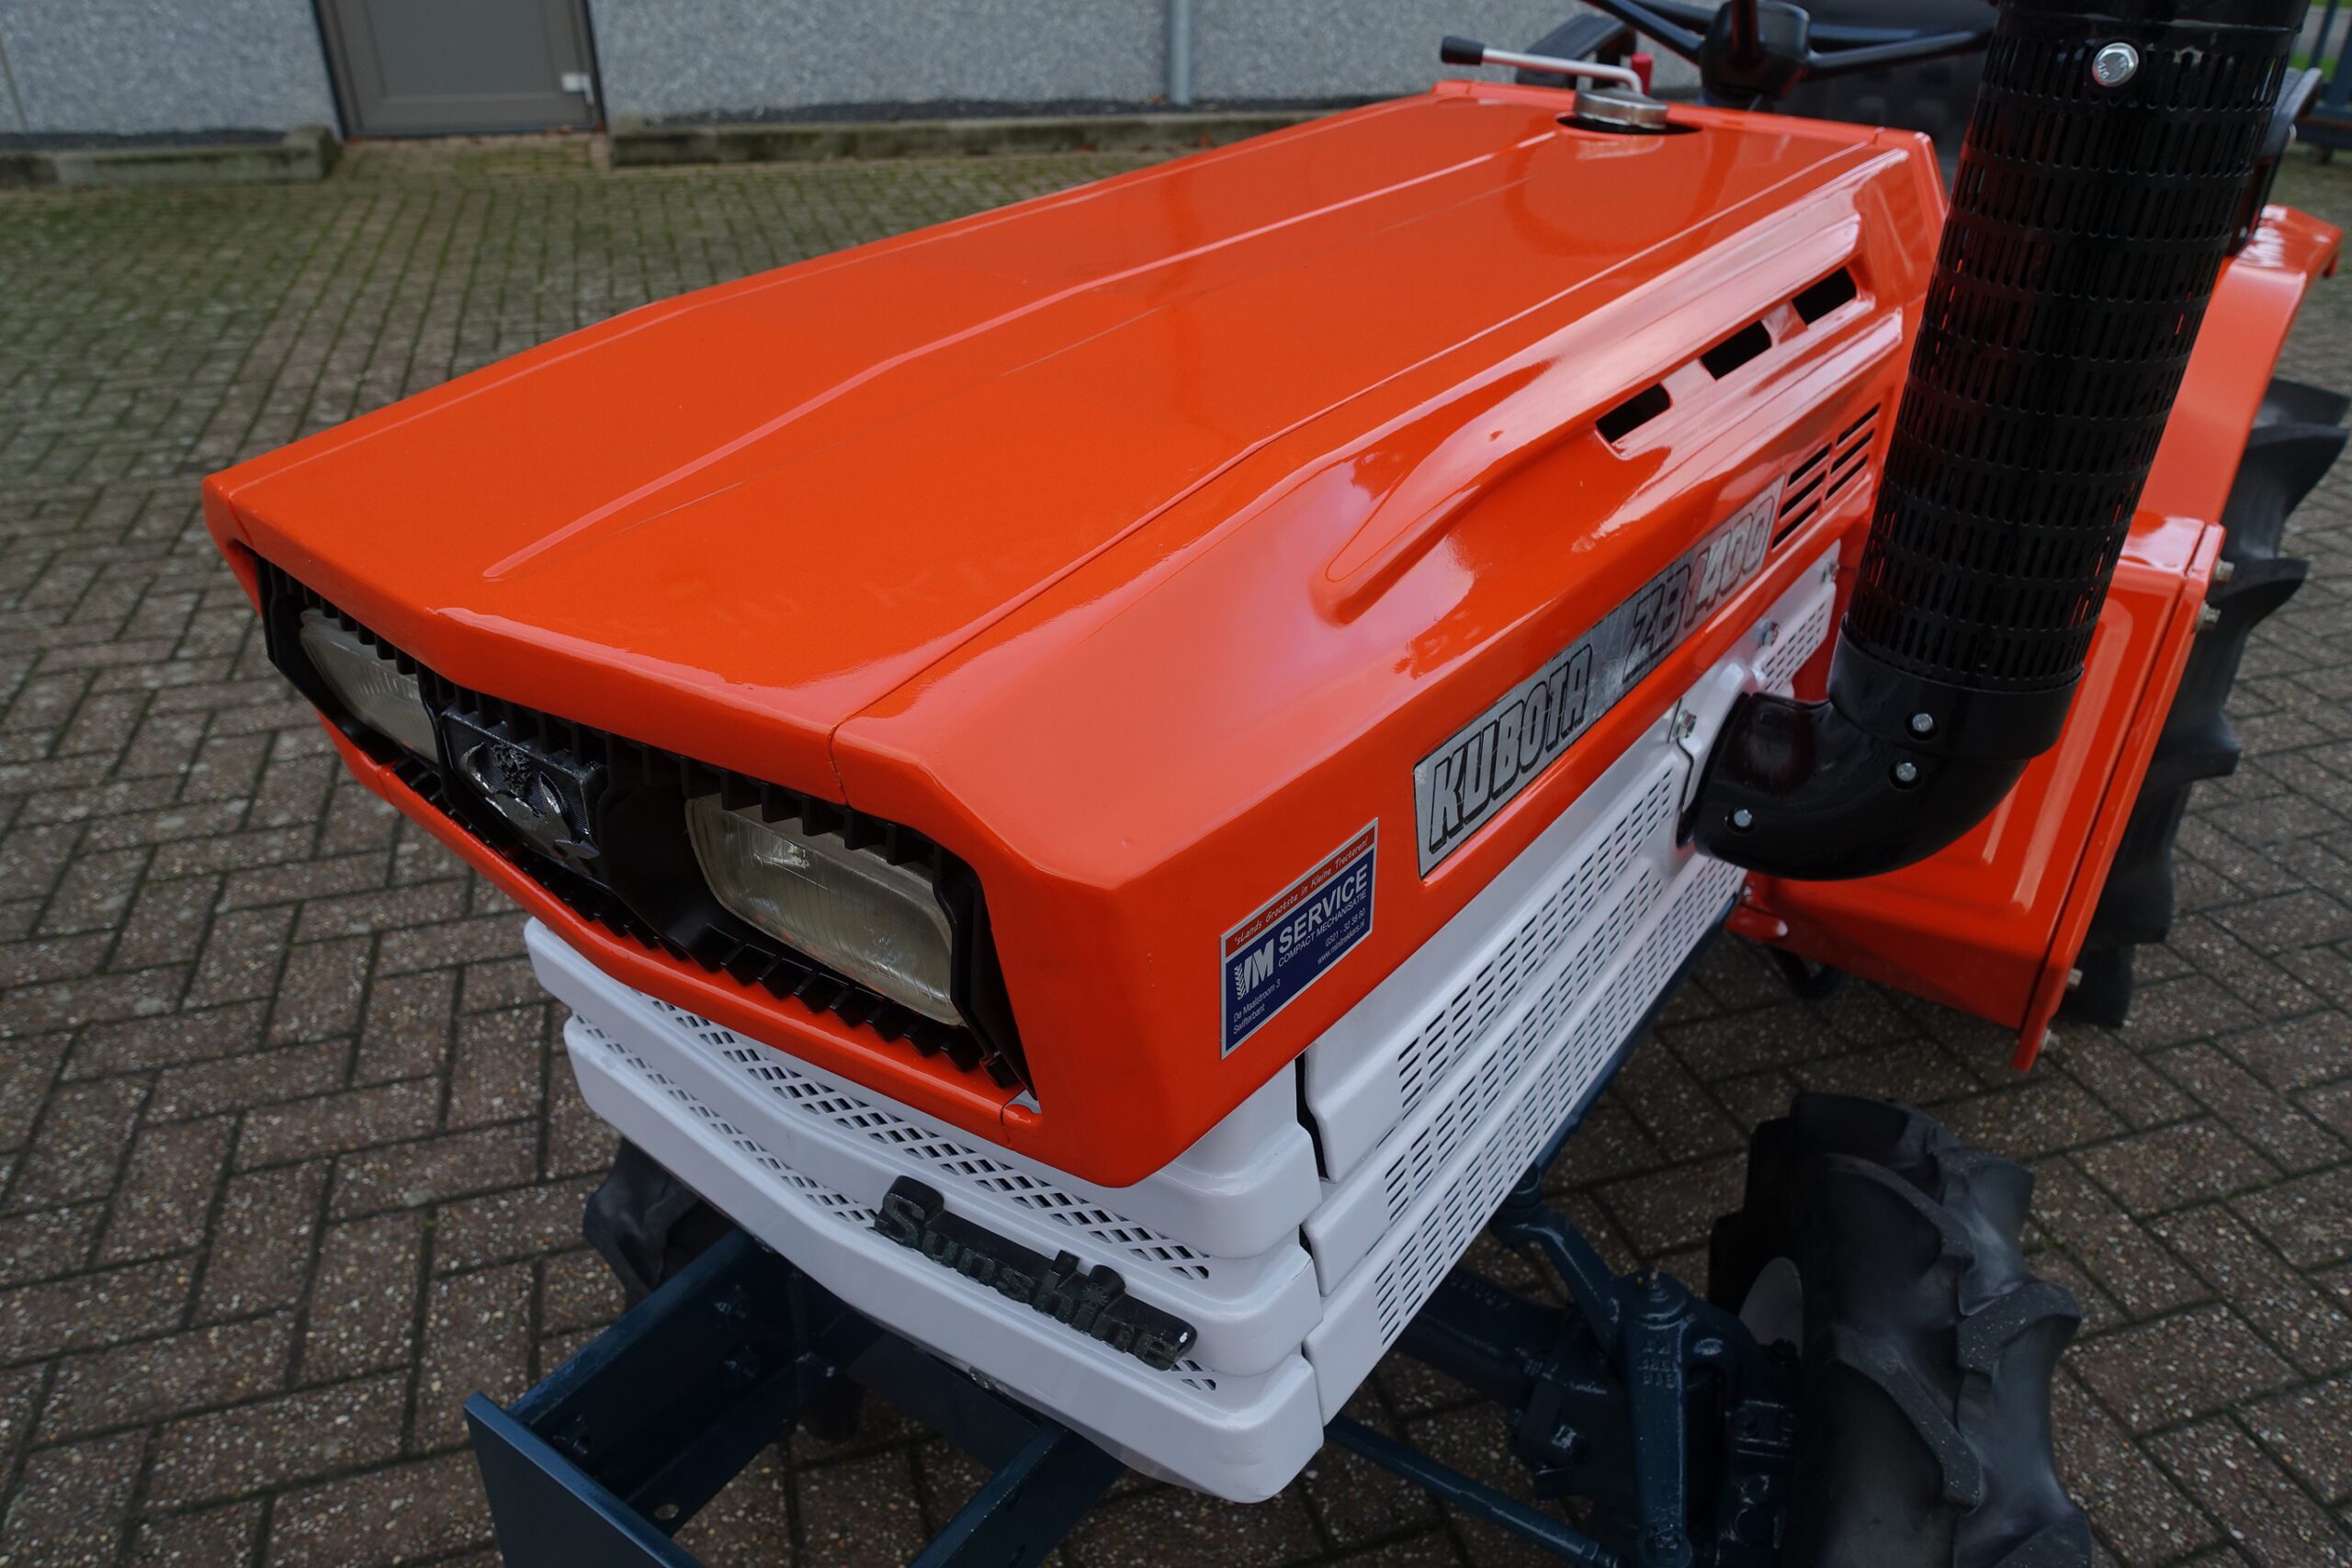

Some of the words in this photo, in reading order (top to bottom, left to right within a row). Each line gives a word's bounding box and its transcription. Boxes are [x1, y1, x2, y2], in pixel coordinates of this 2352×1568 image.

[1429, 644, 1593, 852] KUBOTA
[1266, 894, 1298, 920] Grootste
[1301, 886, 1308, 897] in
[1310, 868, 1332, 889] Kleine
[1335, 837, 1369, 866] Tractoren!
[1279, 863, 1368, 954] SERVICE
[1278, 932, 1317, 968] COMPACT
[1317, 891, 1367, 938] MECHANISATIE
[1233, 1003, 1265, 1035] Swifterbant
[1234, 1010, 1242, 1022] De
[1243, 984, 1275, 1015] Maalstroom
[875, 1177, 1195, 1371] Sunshine
